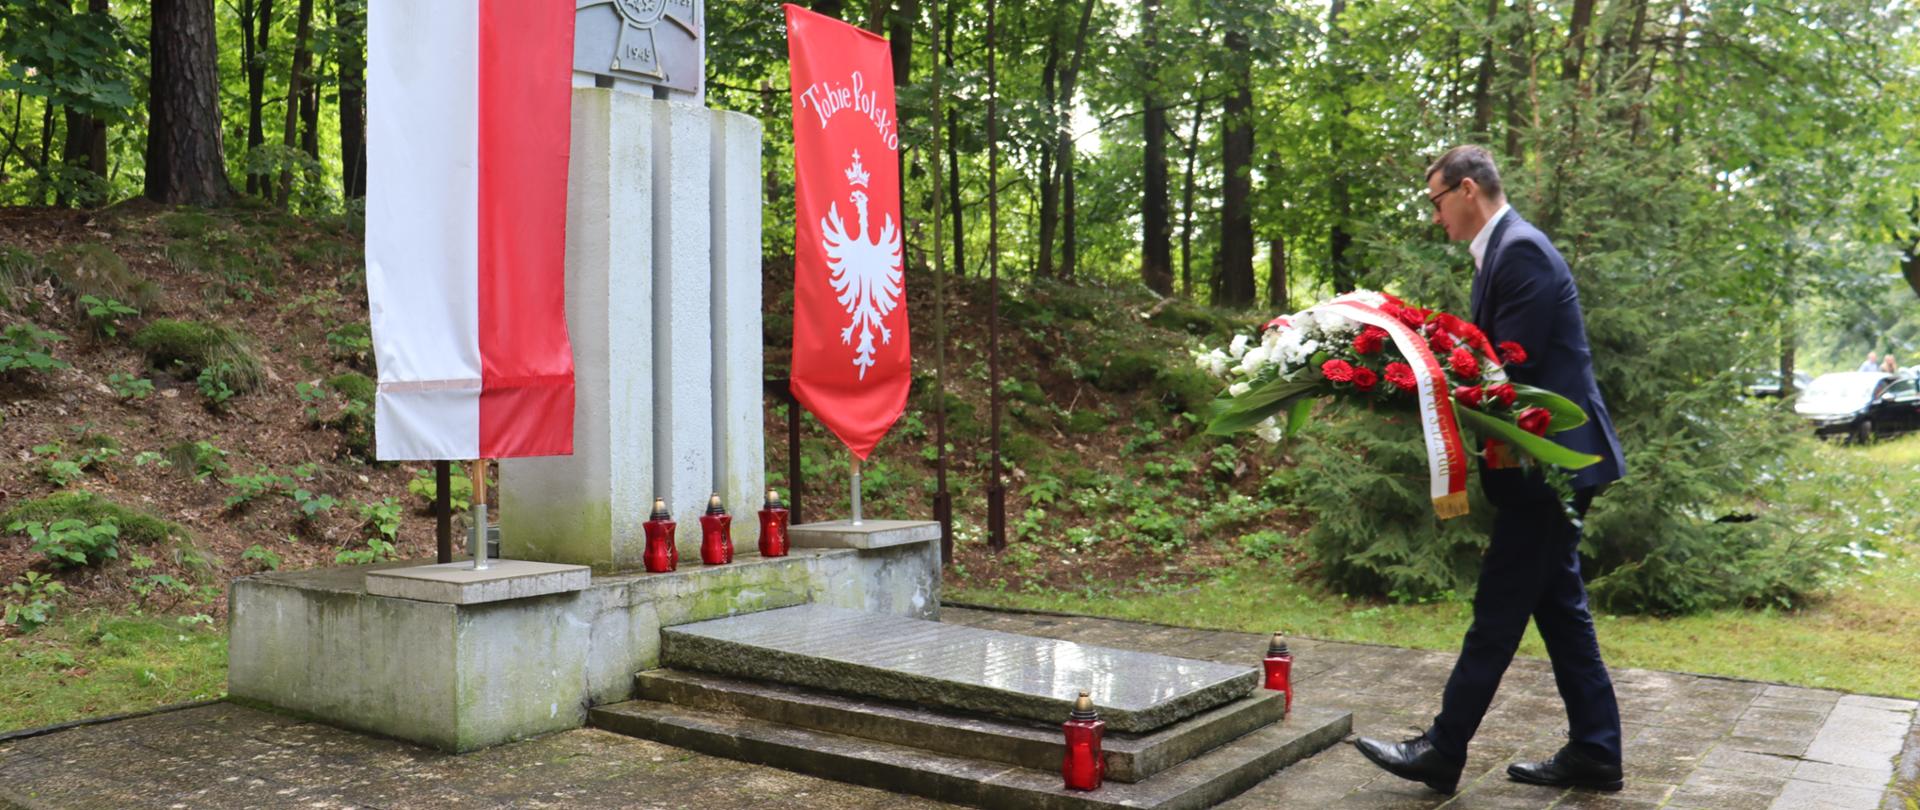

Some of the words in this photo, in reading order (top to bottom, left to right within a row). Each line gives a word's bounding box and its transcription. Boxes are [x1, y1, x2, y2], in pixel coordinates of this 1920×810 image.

[800, 81, 852, 129] Tobie
[851, 71, 898, 151] Polsko
[1429, 412, 1458, 477] PREZES
